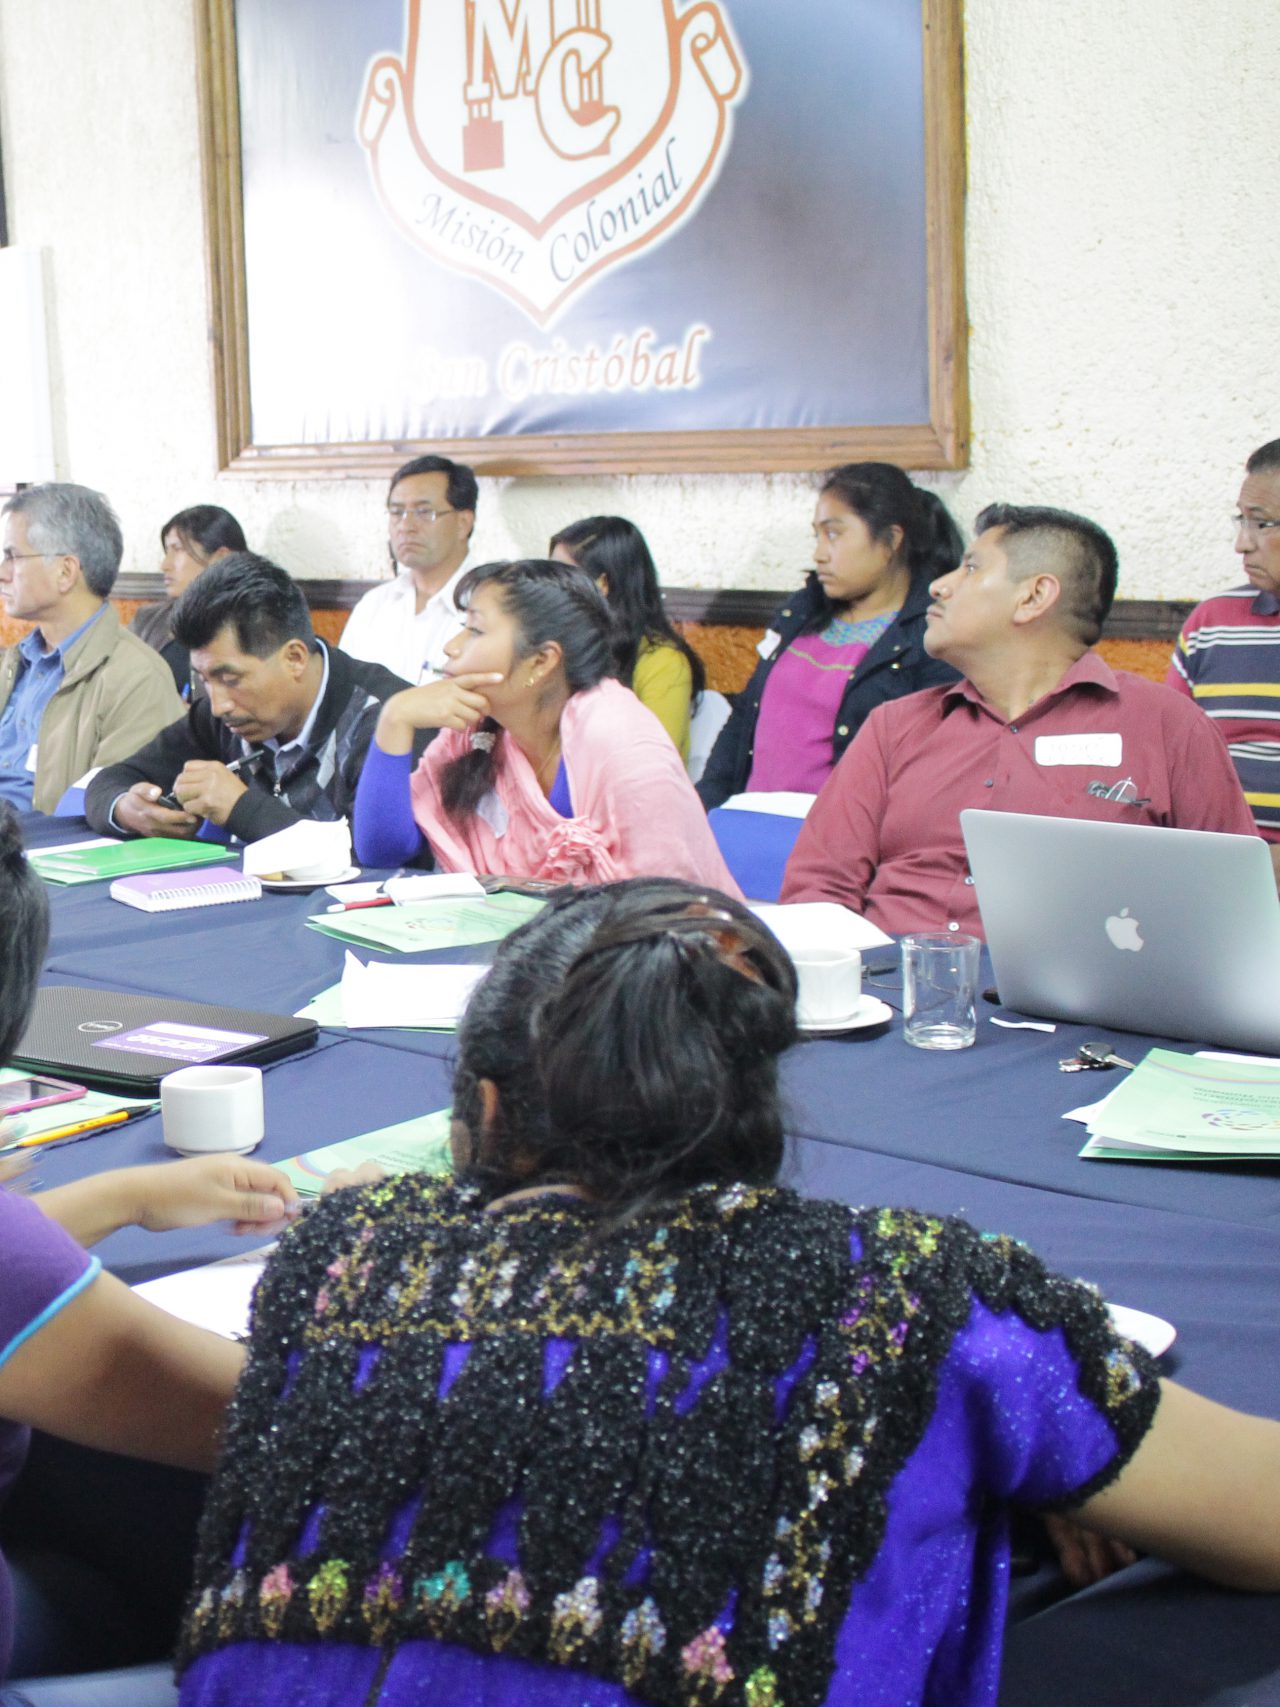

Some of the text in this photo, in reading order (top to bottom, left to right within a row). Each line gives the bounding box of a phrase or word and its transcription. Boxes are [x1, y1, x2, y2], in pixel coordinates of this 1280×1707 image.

[415, 137, 683, 283] Misión Colonial
[500, 326, 707, 396] Cristóbal
